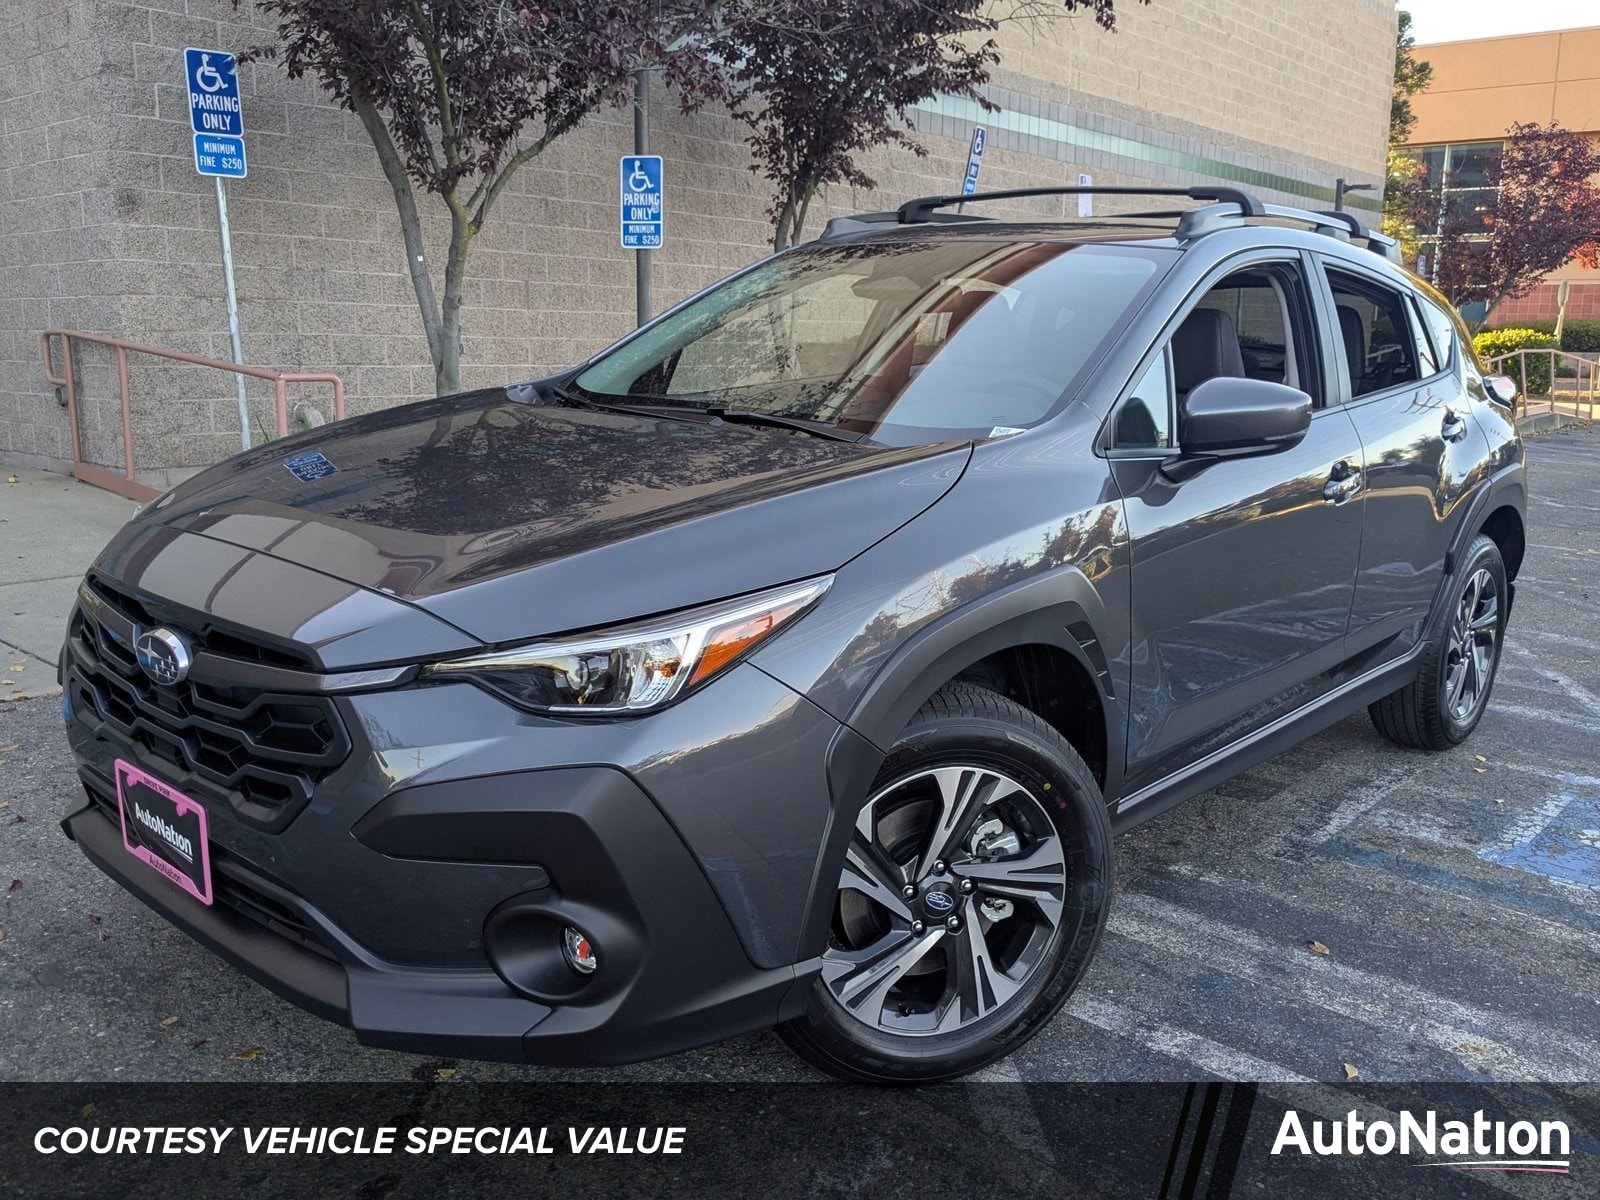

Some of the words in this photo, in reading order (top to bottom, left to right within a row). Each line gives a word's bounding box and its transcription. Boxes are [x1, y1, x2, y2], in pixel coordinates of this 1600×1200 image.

[192, 92, 239, 112] PARKING
[202, 113, 231, 130] ONLY
[203, 142, 236, 155] MINIMUM
[200, 156, 216, 168] FINE
[222, 157, 242, 170] $250
[623, 193, 660, 206] PARKING
[631, 207, 653, 220] ONLY
[628, 225, 655, 234] MINIMUM
[624, 235, 638, 245] FINE
[641, 235, 660, 245] $250
[143, 776, 158, 790] DRIVE
[135, 802, 193, 856] AutoNation
[150, 856, 182, 883] AutoNation
